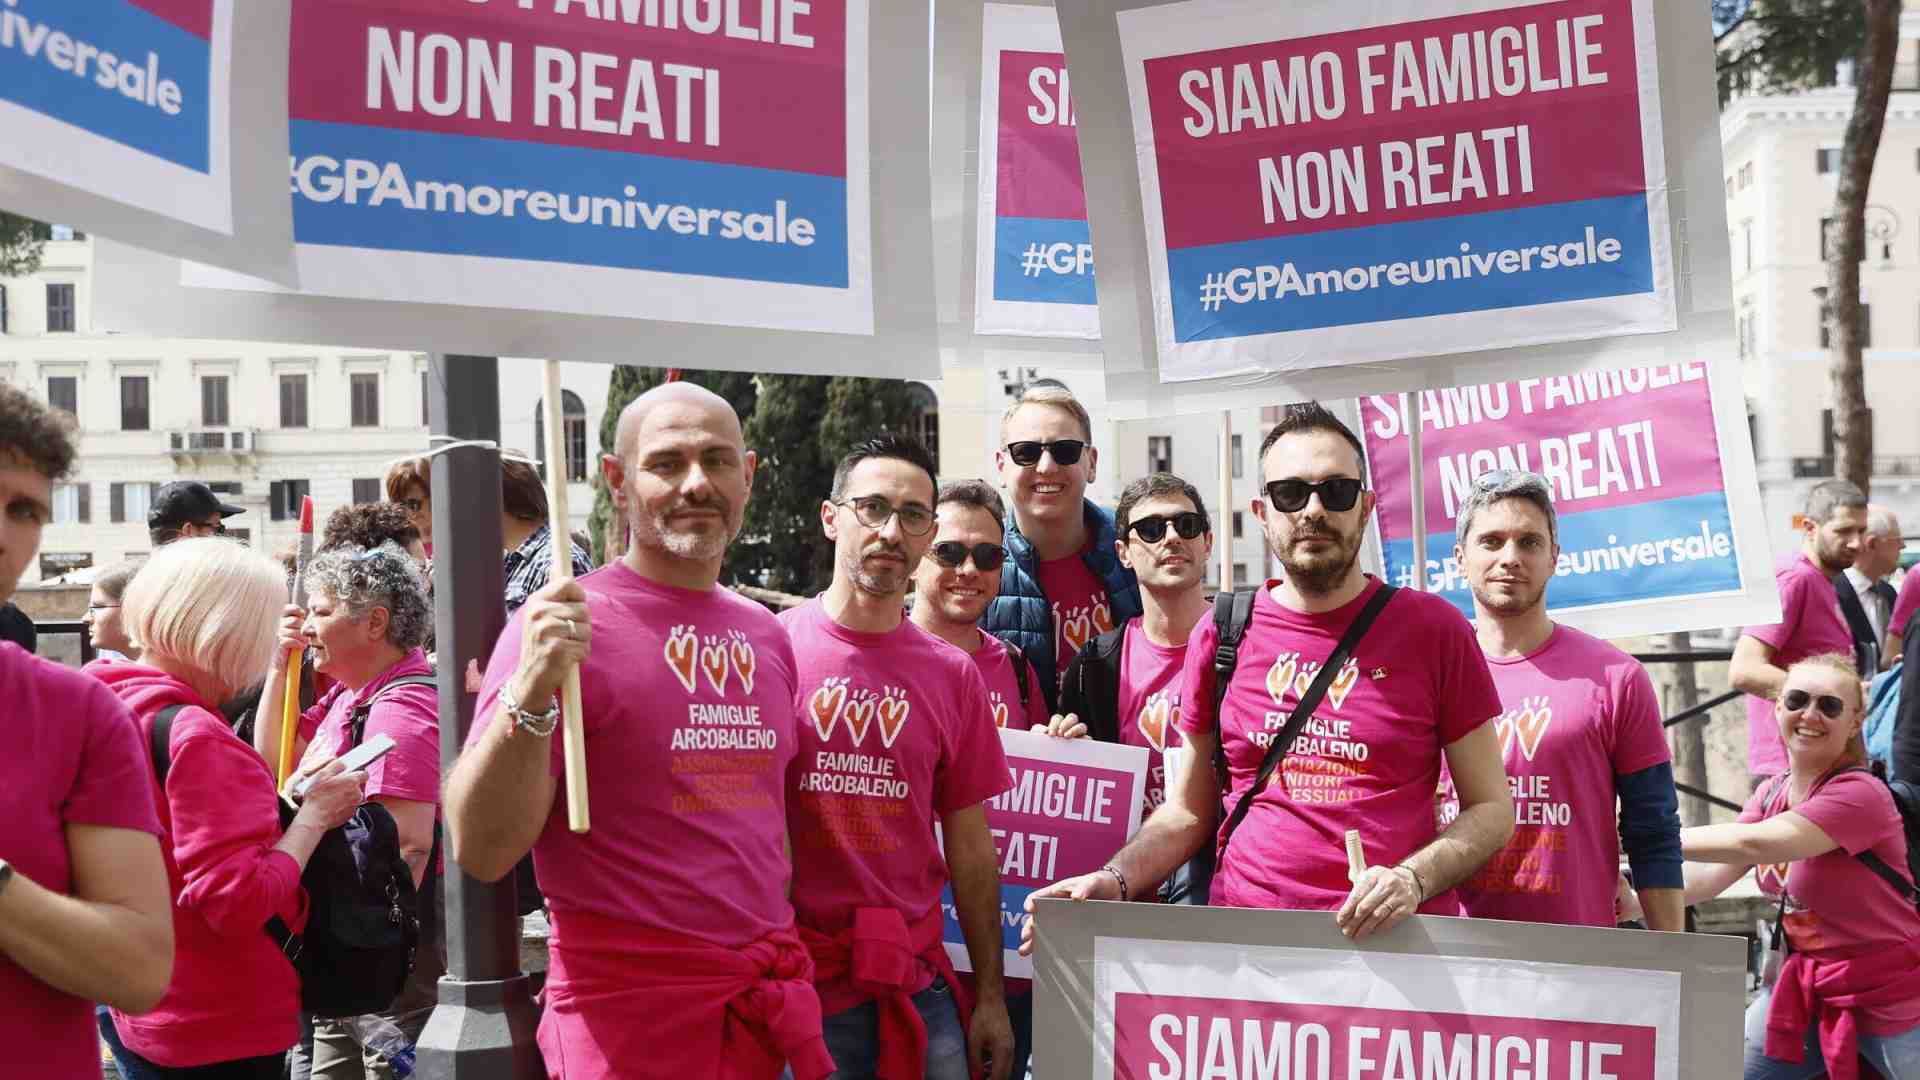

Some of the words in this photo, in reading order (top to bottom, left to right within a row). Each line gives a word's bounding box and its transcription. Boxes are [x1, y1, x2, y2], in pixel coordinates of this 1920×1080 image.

[0, 0, 182, 115] iversale
[366, 26, 513, 122] NON
[533, 45, 721, 147] REATI
[1178, 51, 1346, 138] SIAMO
[1358, 14, 1609, 115] FAMIGLIE
[1028, 66, 1076, 126] SI
[1258, 145, 1368, 224] NON
[1380, 124, 1534, 210] REATI
[1021, 242, 1095, 277] #GP
[1199, 226, 1622, 312] #GPAmoreuniversale
[1540, 419, 1661, 503] REATI
[671, 728, 777, 750] ARCOBALENO
[688, 704, 761, 726] FAMIGLIE
[1264, 711, 1352, 739] FAIGLIE
[799, 772, 909, 799] ARCOBALENO
[816, 751, 895, 776] FAMIGLIE
[1149, 1013, 1331, 1080] SIAMO
